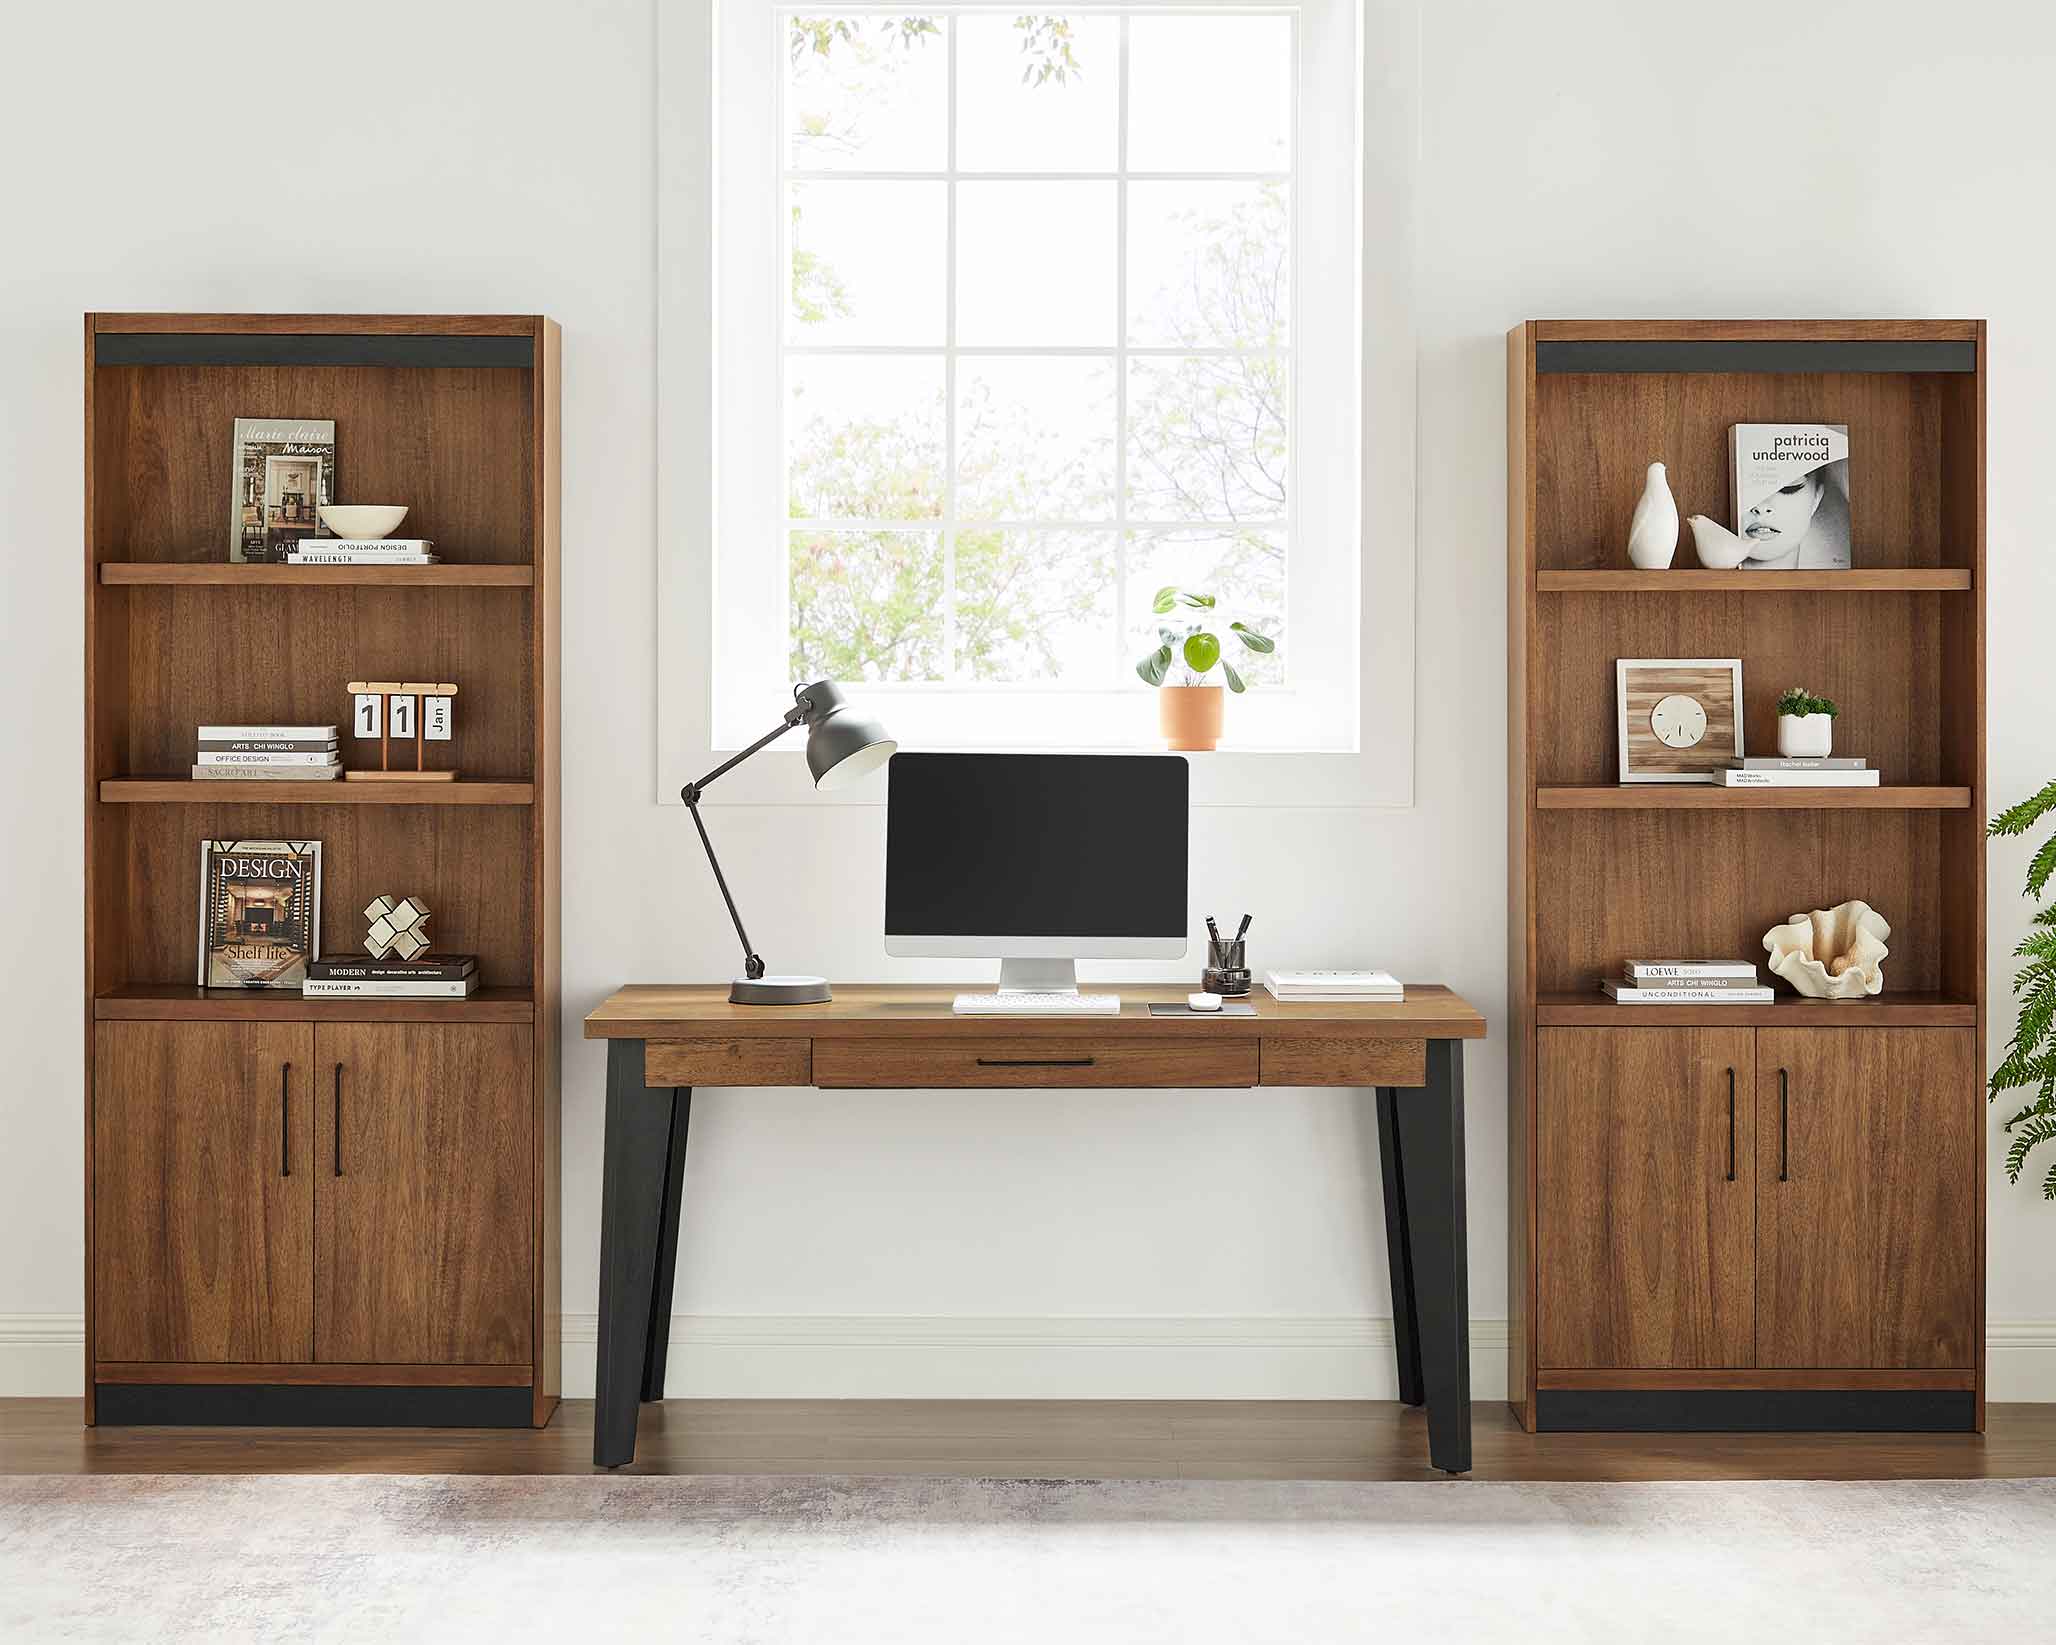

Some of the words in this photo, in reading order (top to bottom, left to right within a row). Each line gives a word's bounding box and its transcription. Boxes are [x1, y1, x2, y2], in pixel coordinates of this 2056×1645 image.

[240, 424, 283, 440] Marie
[288, 425, 329, 441] claire
[1774, 433, 1829, 450] patricia
[282, 443, 332, 454] Maison
[1752, 447, 1829, 460] underwood
[302, 555, 352, 563] WAVELENGTH
[432, 707, 444, 732] Jan
[215, 755, 241, 763] OFFICE
[242, 755, 270, 763] DESIGN
[219, 858, 304, 878] DESIGN
[227, 945, 263, 960] Shelf
[266, 945, 287, 960] life
[329, 968, 367, 976] MODERN
[1646, 967, 1679, 976] LOEWE
